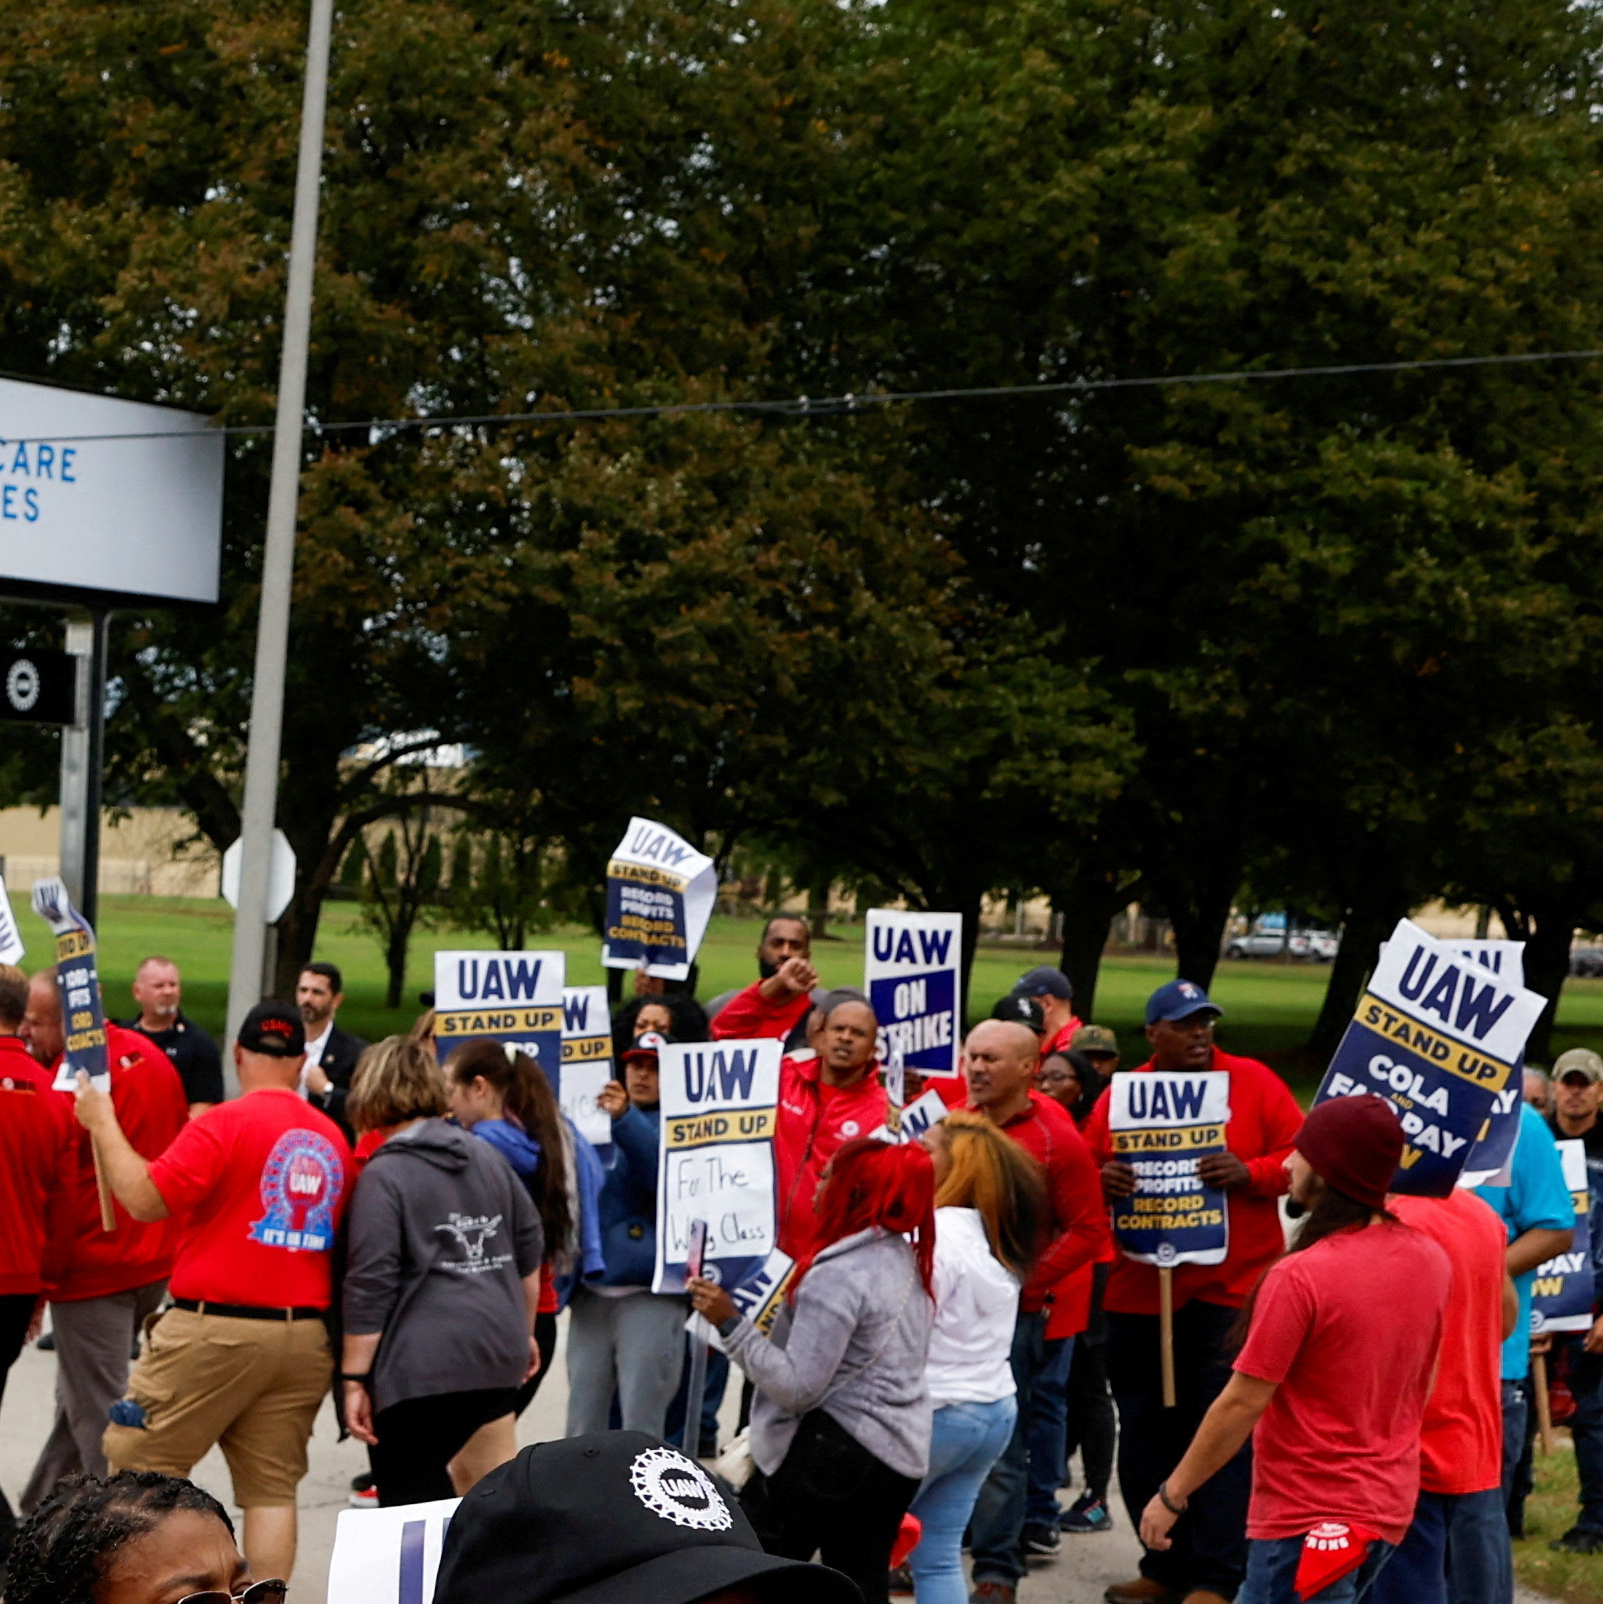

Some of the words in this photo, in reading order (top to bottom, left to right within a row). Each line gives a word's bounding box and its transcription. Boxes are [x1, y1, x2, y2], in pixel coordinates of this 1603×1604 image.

[632, 826, 693, 866] UAW
[873, 926, 953, 965] UAW
[459, 959, 542, 999] UAW
[1398, 944, 1515, 1041] UAW
[894, 978, 926, 1019] ON
[444, 1014, 516, 1031] STAND
[525, 1012, 554, 1027] UP
[875, 1010, 953, 1061] STRIKE
[580, 1041, 605, 1055] UP
[1364, 1005, 1451, 1065] STAND
[1458, 1053, 1498, 1086] UP
[684, 1049, 757, 1103] UAW
[1368, 1054, 1449, 1116] COLA
[1129, 1080, 1207, 1119] UAW
[1390, 1092, 1413, 1109] AND
[673, 1119, 728, 1142] STAND
[739, 1115, 768, 1134] UP
[1117, 1133, 1182, 1149] STAND
[1191, 1129, 1219, 1143] UP
[290, 1172, 322, 1195] UAW
[706, 1157, 749, 1188] The
[1134, 1176, 1204, 1194] PROFITS
[1117, 1209, 1223, 1230] CONTRACTS
[1134, 1195, 1205, 1213] RECORD
[720, 1212, 766, 1245] Class
[661, 1478, 704, 1500] UAW
